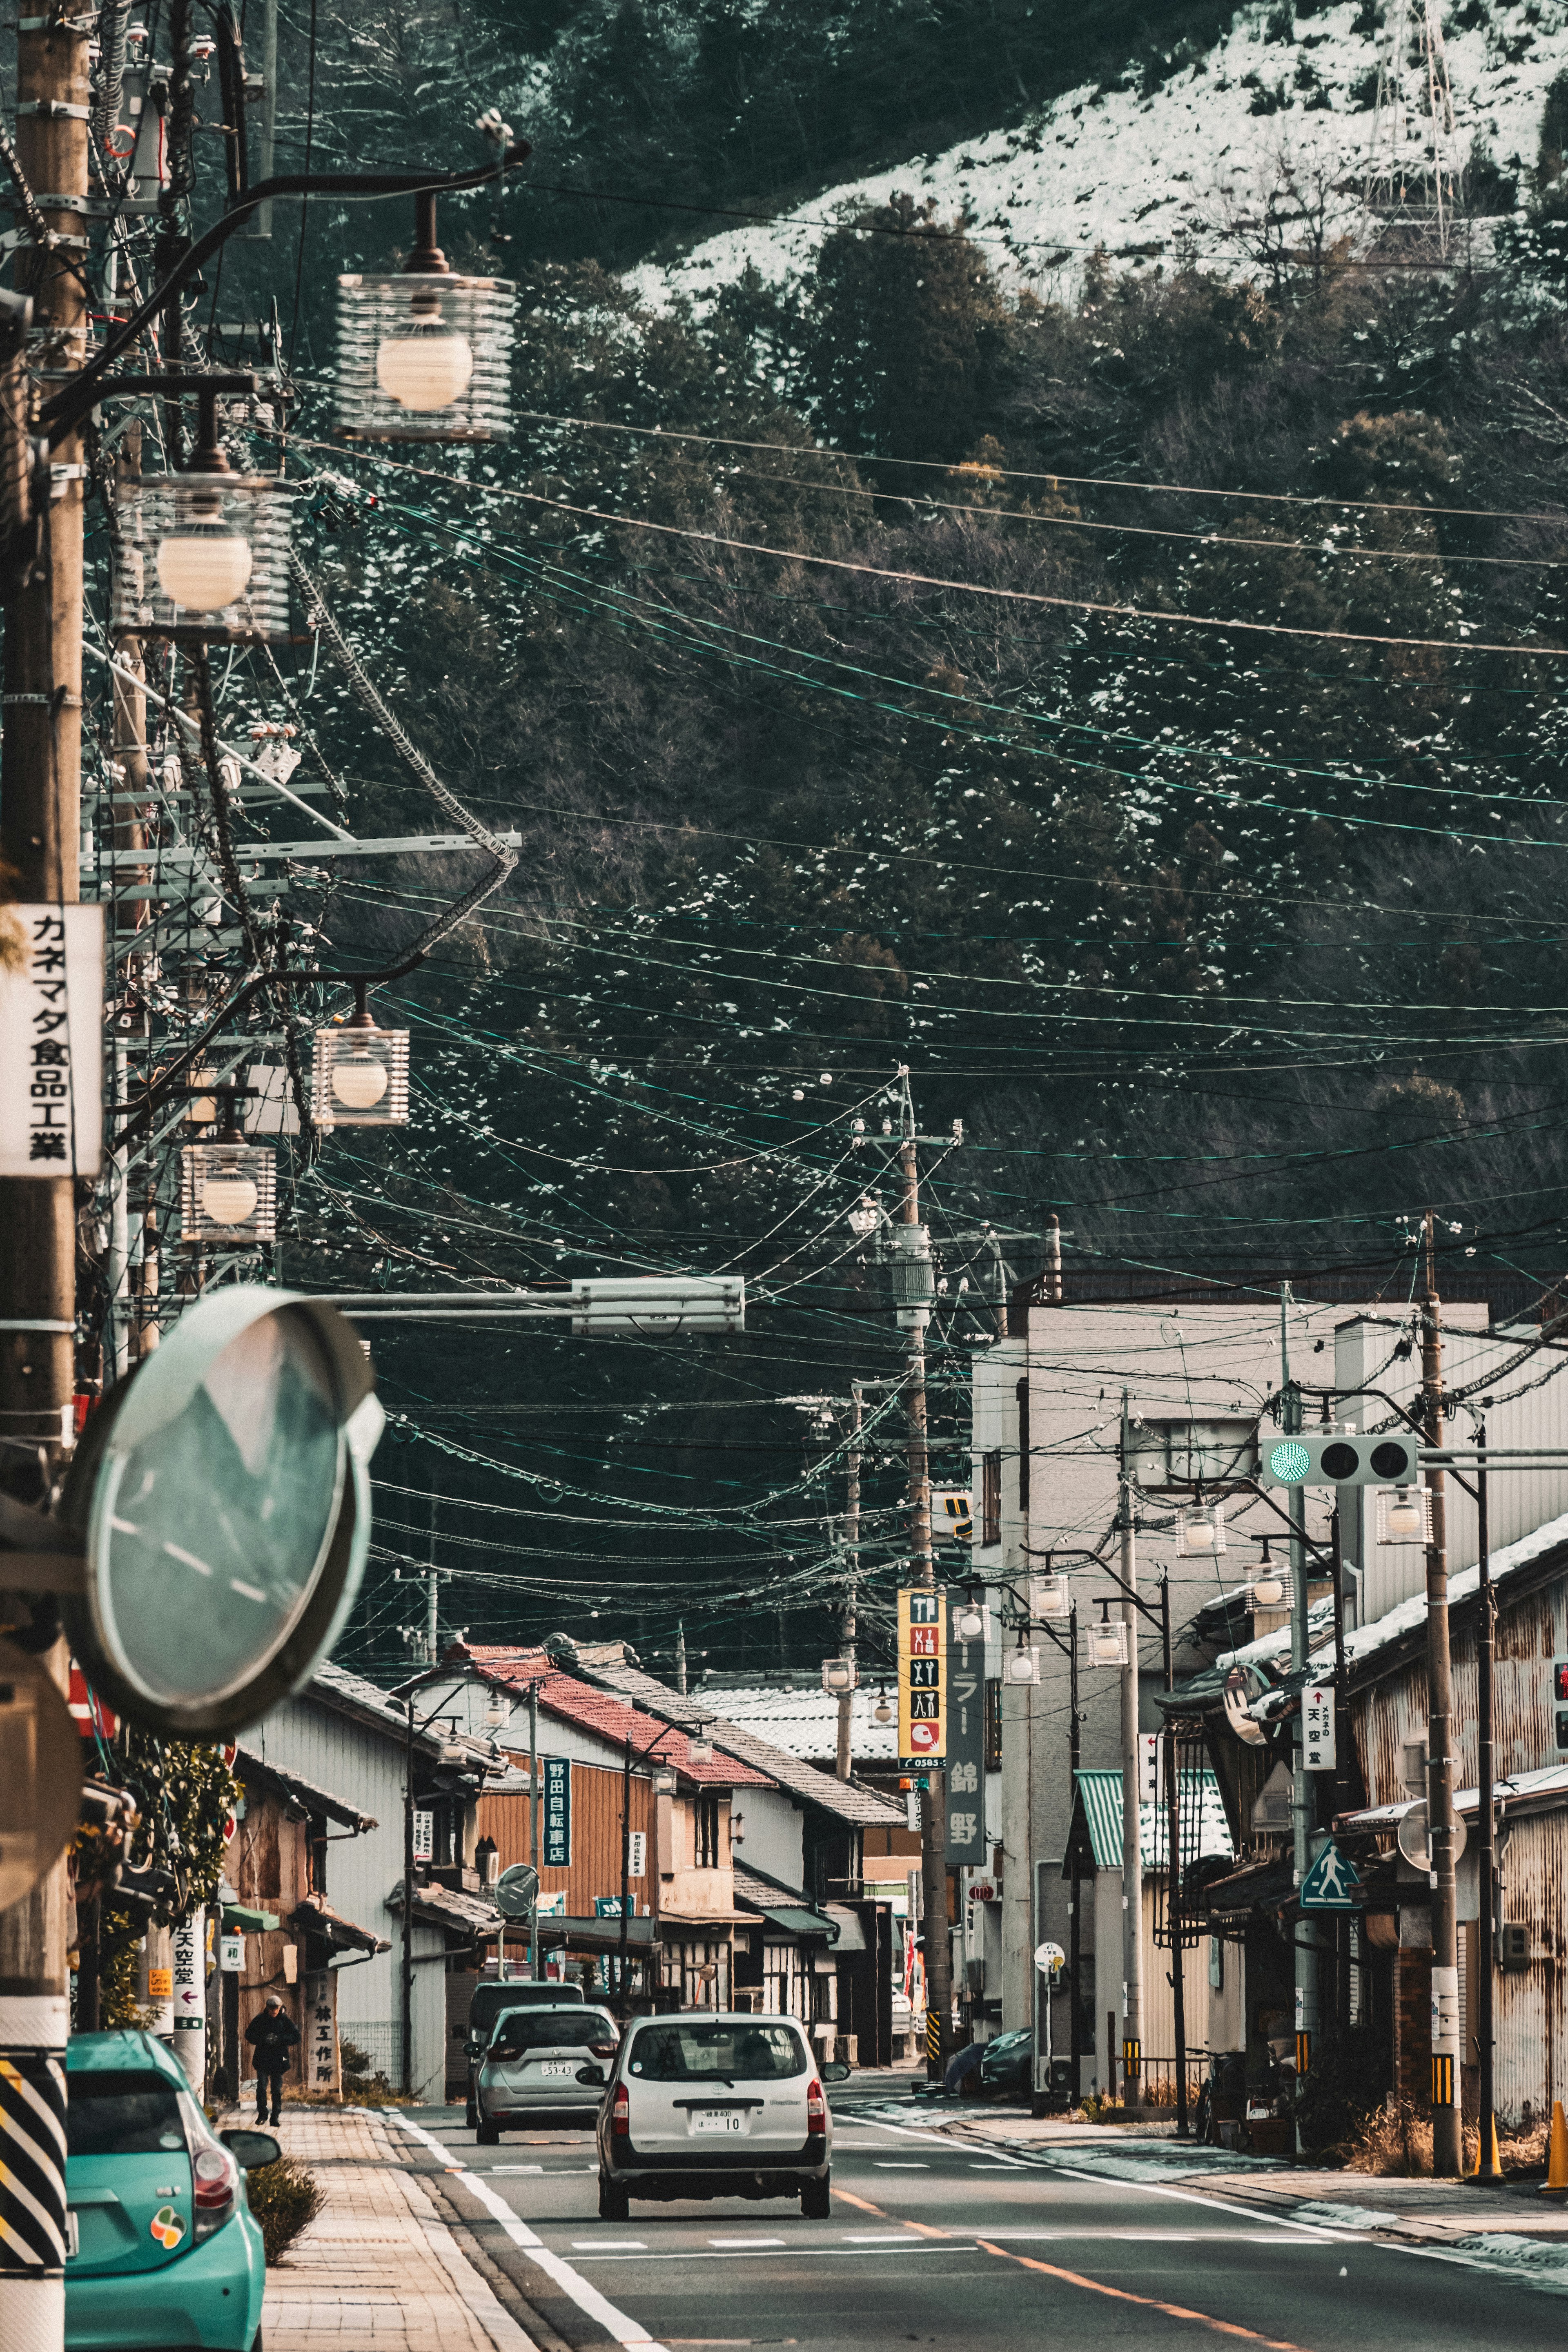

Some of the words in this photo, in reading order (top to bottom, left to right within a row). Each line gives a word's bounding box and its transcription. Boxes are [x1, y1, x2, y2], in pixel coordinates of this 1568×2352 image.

[30, 915, 69, 1161] カネマタ食品工業
[953, 1642, 978, 1735] ーラー
[1308, 1708, 1321, 1764] 天空堂
[549, 1764, 564, 1862] 野田自転車店
[951, 1762, 978, 1844] 錦野
